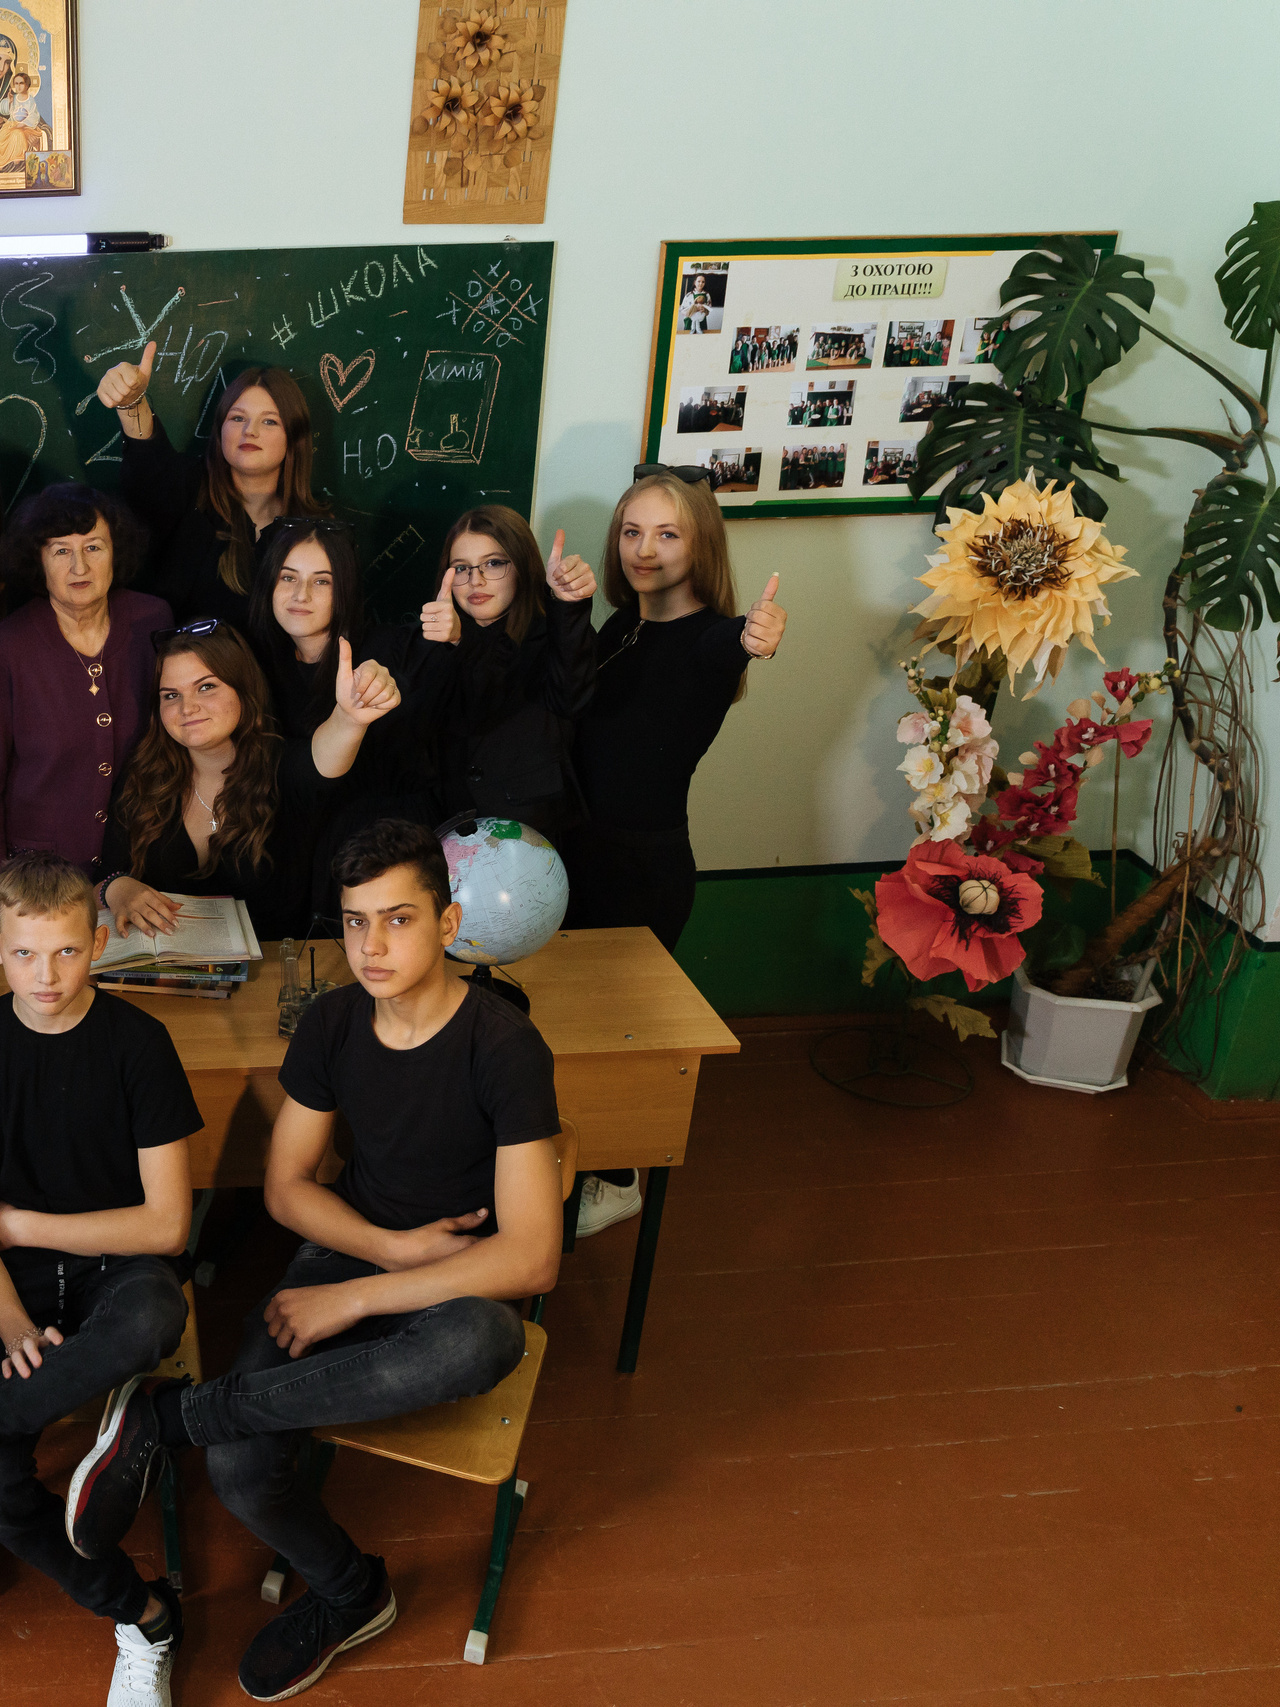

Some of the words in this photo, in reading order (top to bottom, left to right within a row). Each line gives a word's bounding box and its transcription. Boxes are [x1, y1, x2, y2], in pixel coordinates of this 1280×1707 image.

[850, 264, 859, 277] З
[862, 263, 933, 277] ОХОТОЮ
[843, 284, 867, 299] ДО
[870, 283, 933, 296] ПРАЦІ!!!
